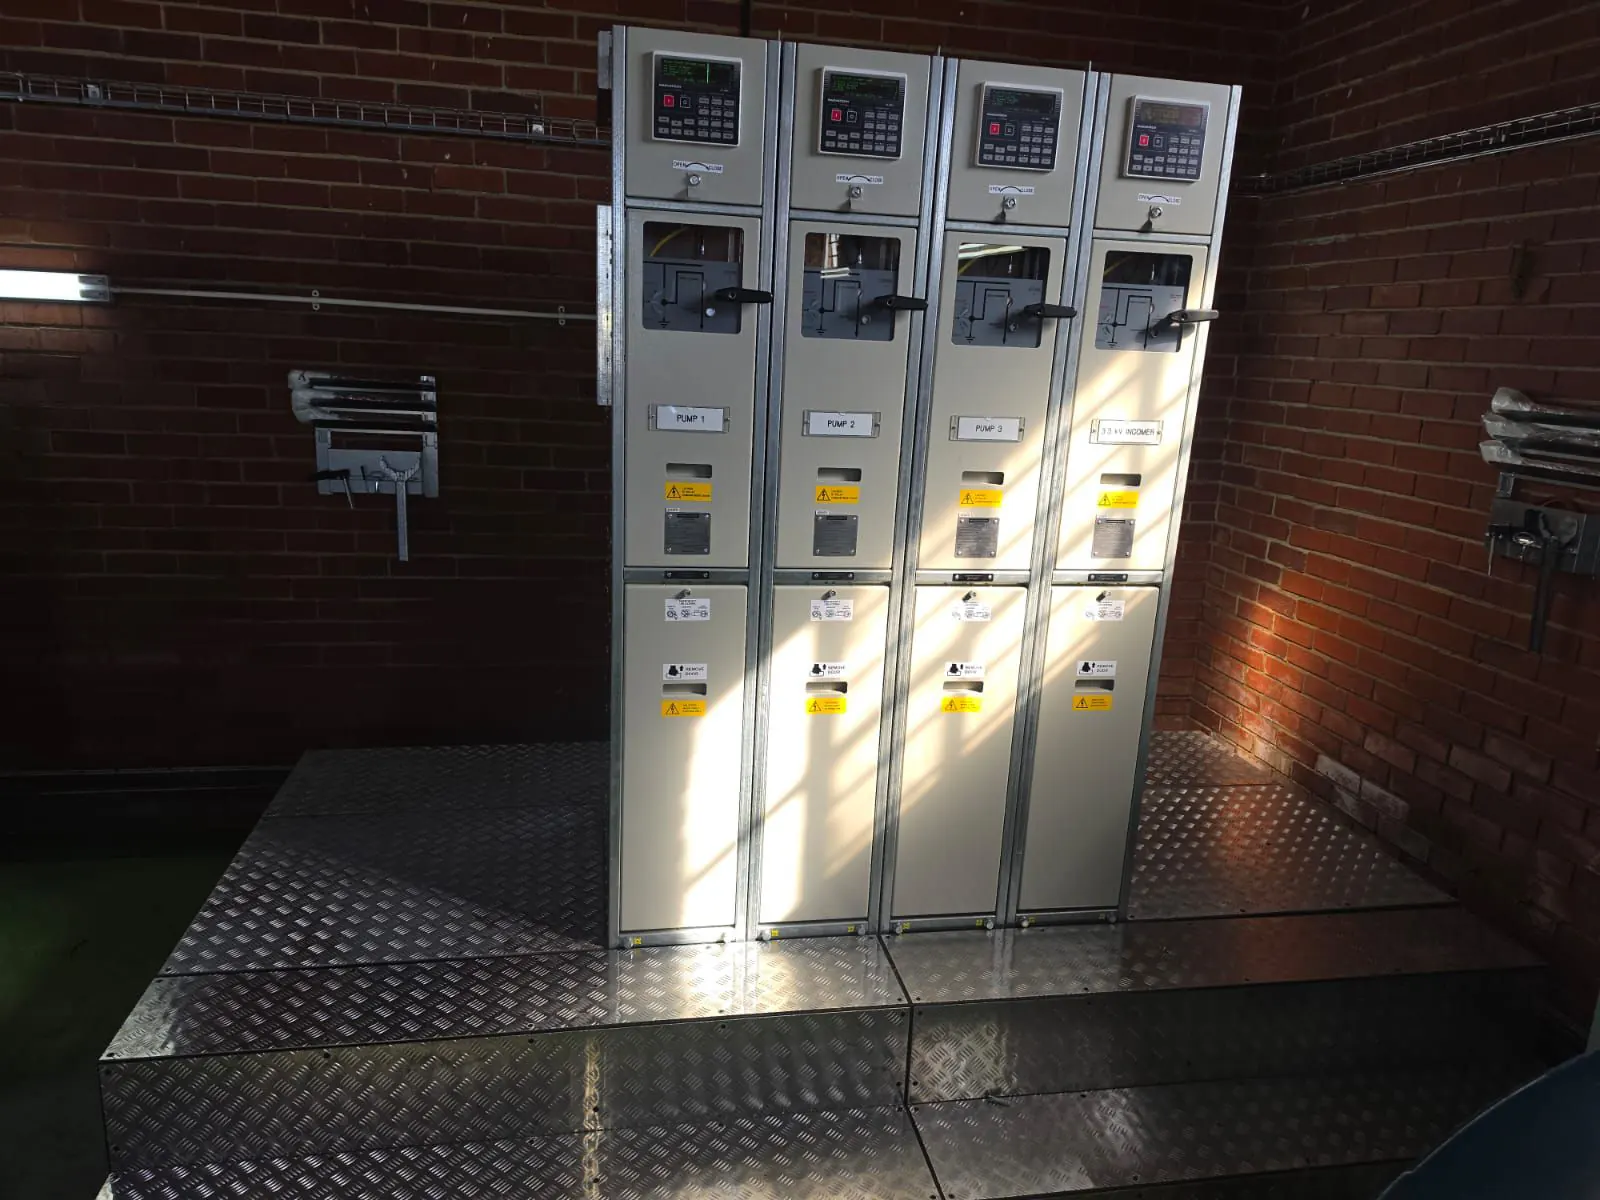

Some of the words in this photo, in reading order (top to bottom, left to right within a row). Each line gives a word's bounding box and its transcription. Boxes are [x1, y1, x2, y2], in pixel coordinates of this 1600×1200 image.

[676, 414, 698, 423] PUMP
[700, 415, 705, 424] 1
[827, 419, 847, 428] PUMP
[850, 420, 855, 429] 2
[975, 424, 995, 433] PUMP
[997, 424, 1003, 433] 3
[1125, 428, 1155, 436] INCOMER
